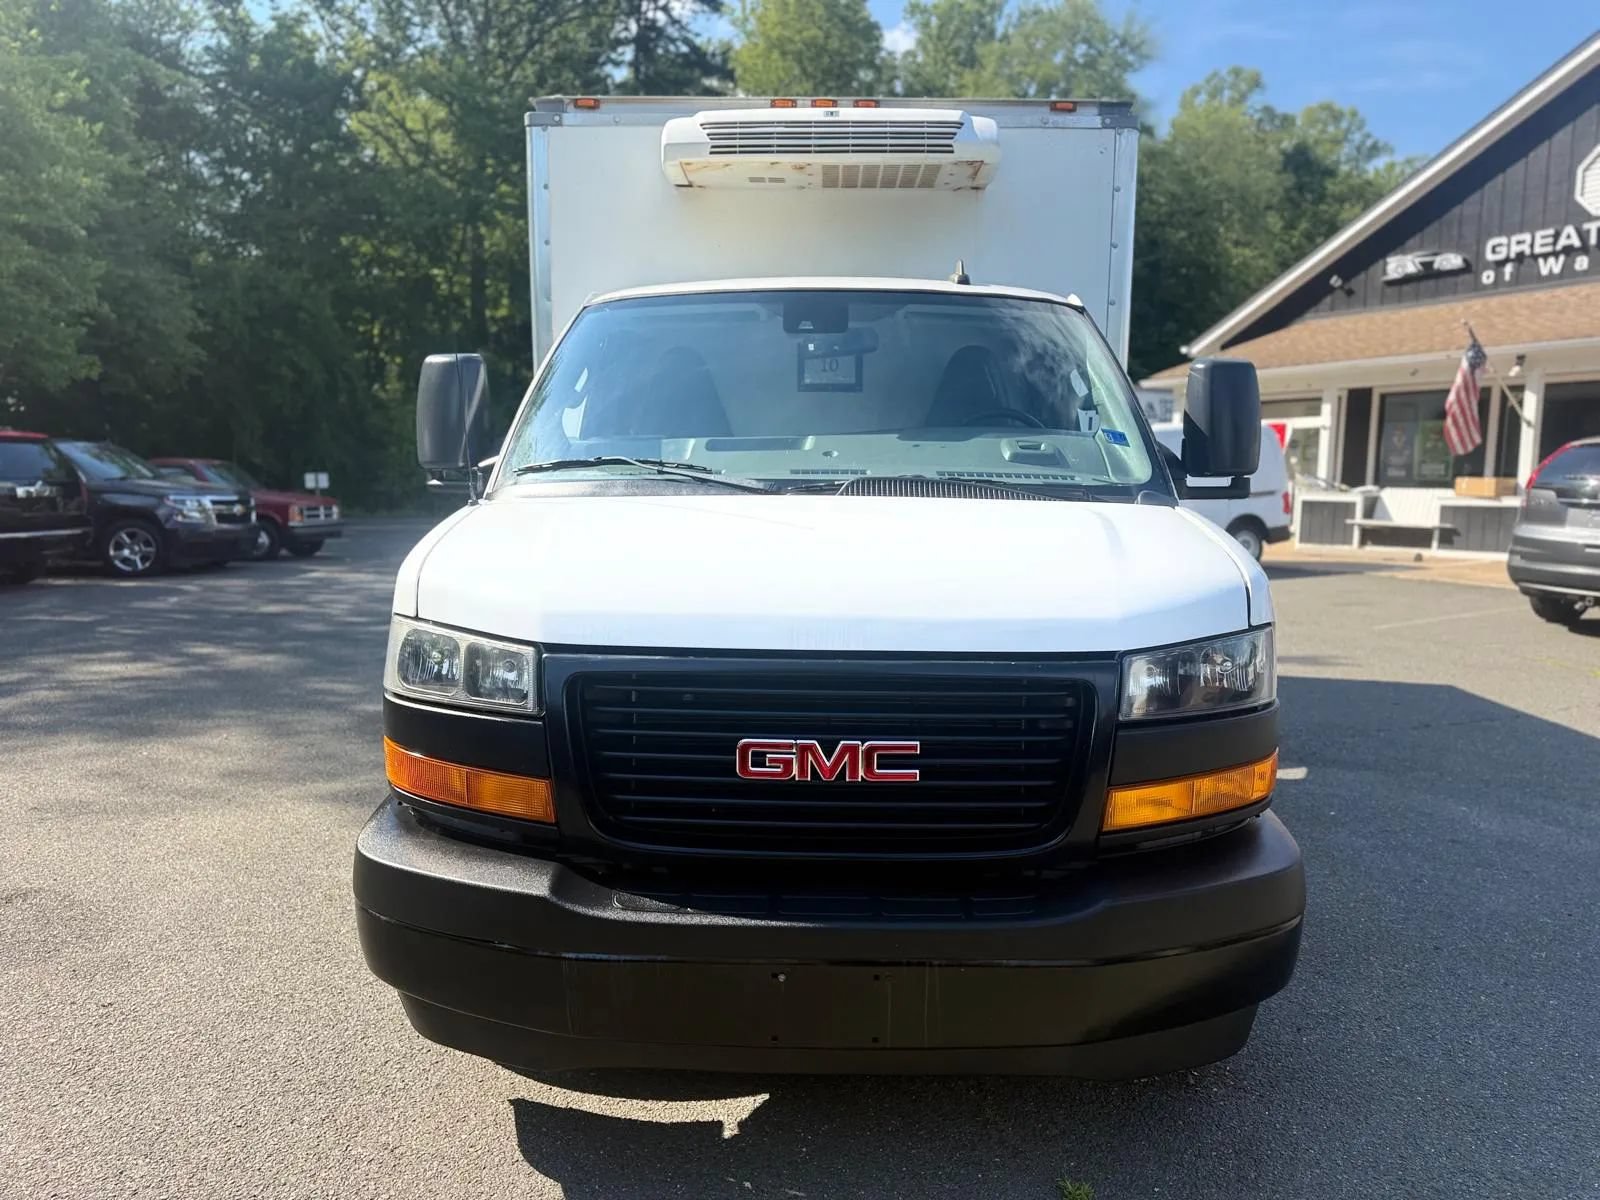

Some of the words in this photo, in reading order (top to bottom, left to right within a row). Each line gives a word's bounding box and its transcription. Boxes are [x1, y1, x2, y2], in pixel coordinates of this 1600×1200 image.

[1485, 221, 1600, 262] GREAT
[1481, 261, 1514, 285] of
[736, 738, 920, 782] GMC
